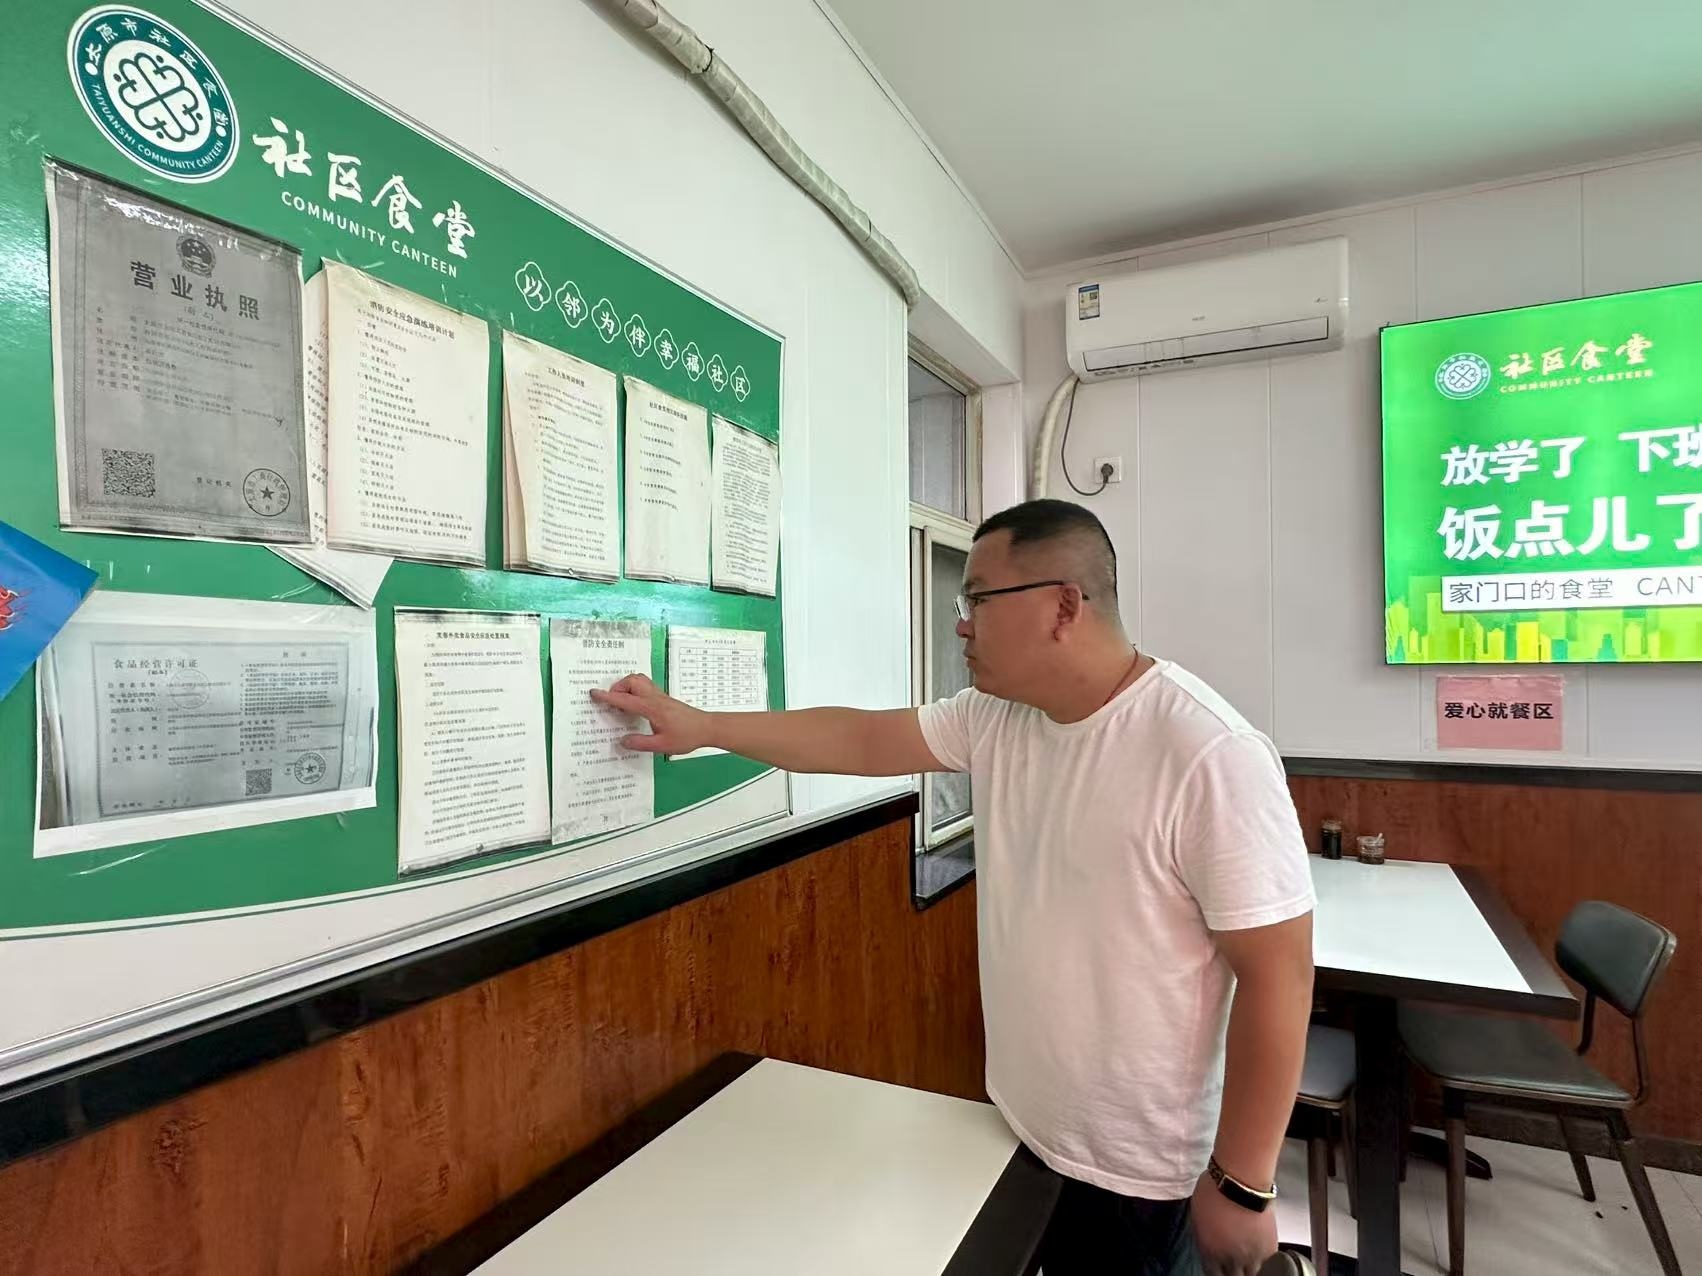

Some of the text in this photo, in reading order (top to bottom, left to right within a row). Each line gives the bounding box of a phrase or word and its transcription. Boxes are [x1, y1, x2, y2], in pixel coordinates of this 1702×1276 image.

[91, 83, 225, 169] TAIYUANSHI COMMUNITY CANTEEN
[251, 116, 477, 260] 社区食堂
[280, 190, 458, 279] COMMUNITY CANTEEN
[130, 260, 261, 321] 营业执照
[522, 273, 746, 395] 以邻为伴幸福社区
[1500, 333, 1654, 379] 社区食堂
[1499, 368, 1654, 394] COMMUNITY CANTEEN
[1440, 436, 1587, 487] 放学了
[1436, 494, 1702, 561] 饭点儿了
[1449, 577, 1614, 603] 家门口的食堂
[1444, 702, 1554, 720] 爱心就餐区
